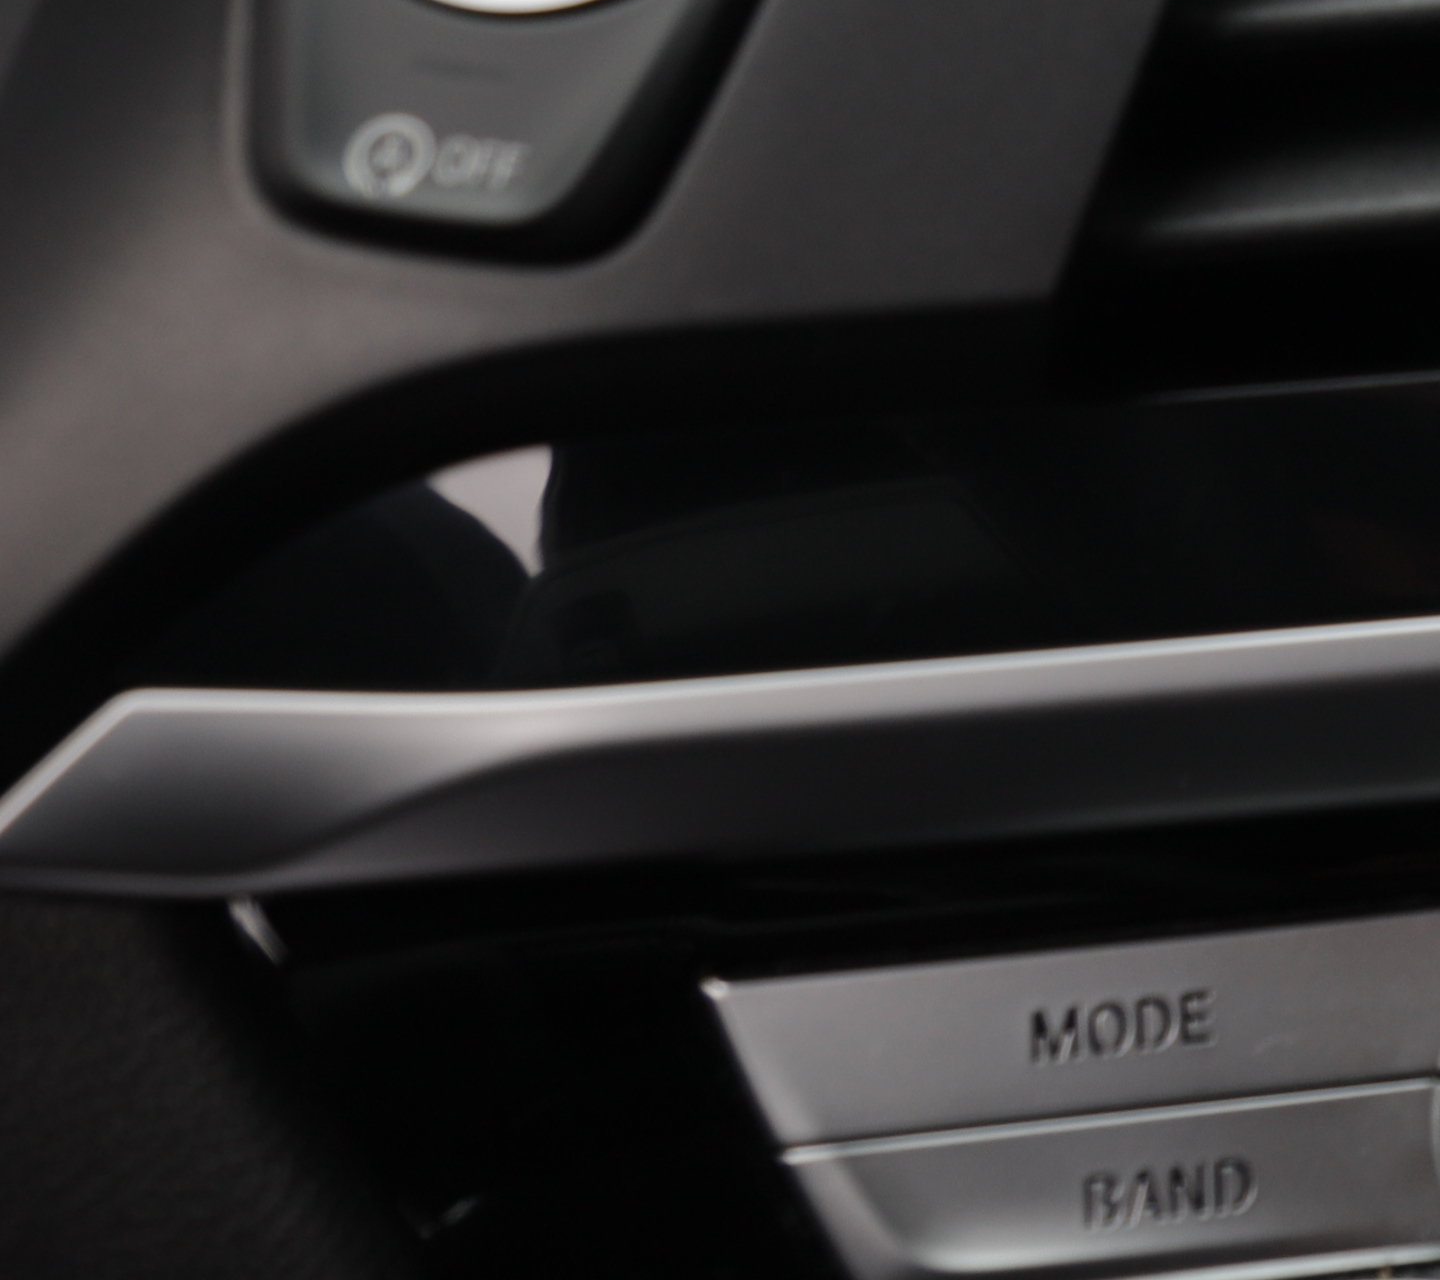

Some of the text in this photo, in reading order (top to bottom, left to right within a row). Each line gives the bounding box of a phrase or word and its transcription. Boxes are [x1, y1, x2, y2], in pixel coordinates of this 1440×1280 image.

[431, 133, 533, 190] OFF
[1030, 989, 1217, 1066] MODE
[1082, 1155, 1259, 1231] BAND
